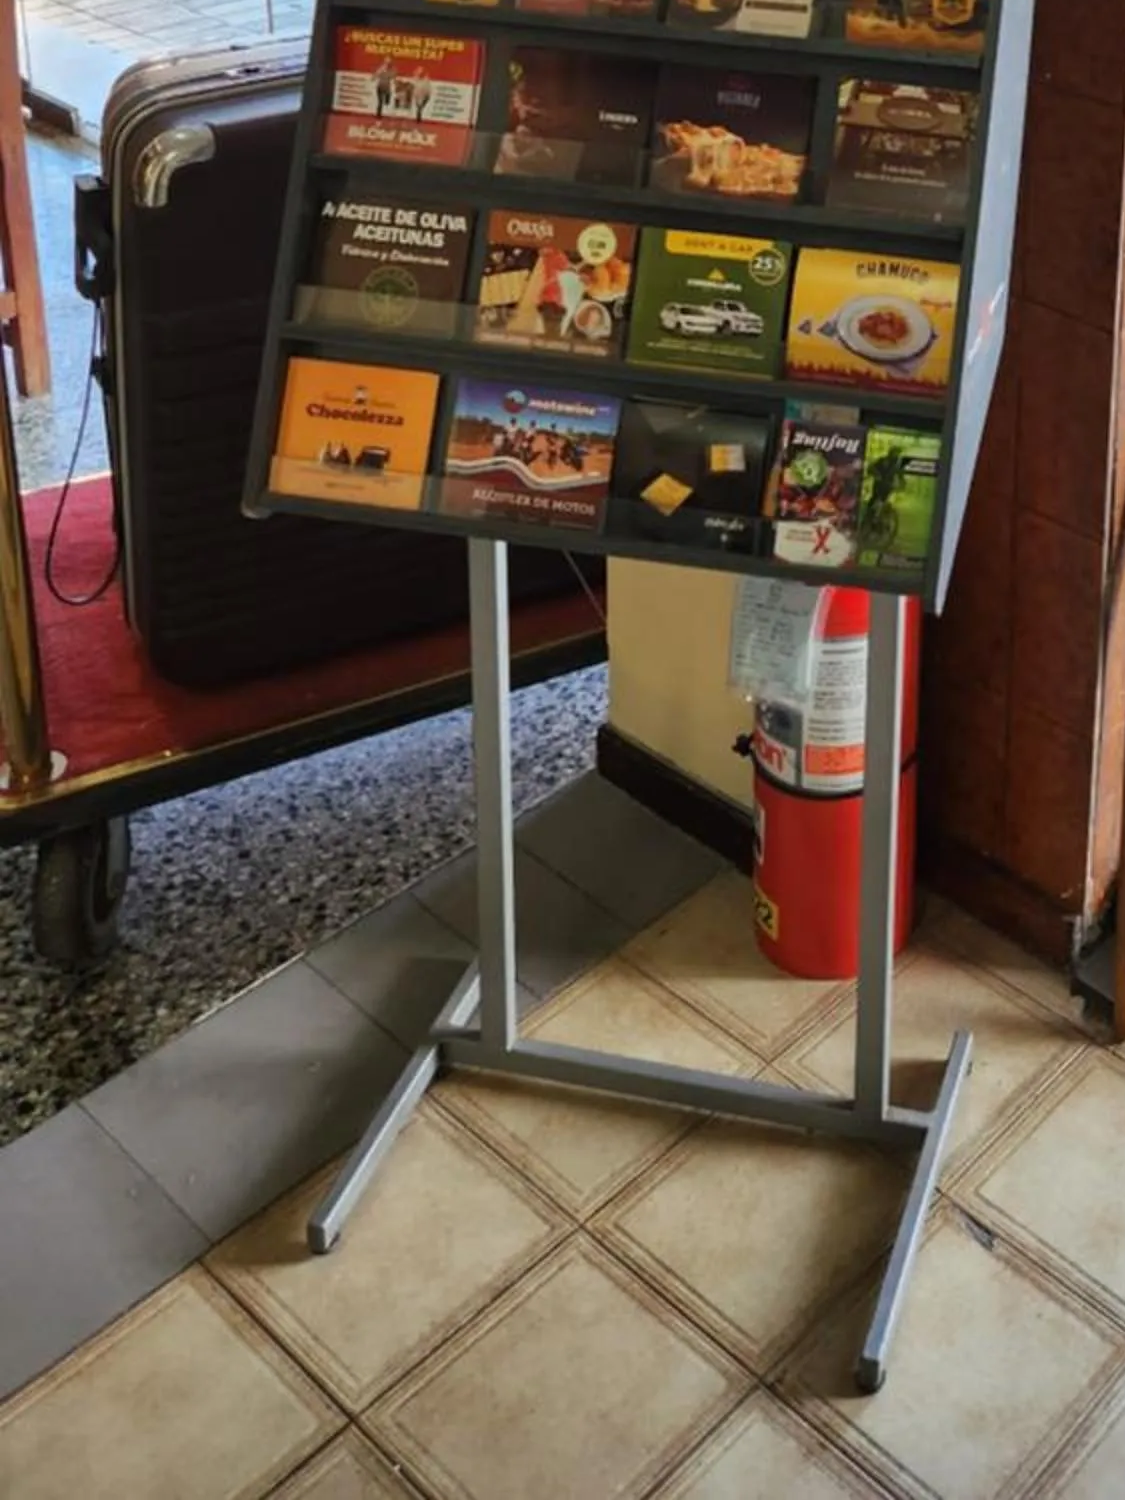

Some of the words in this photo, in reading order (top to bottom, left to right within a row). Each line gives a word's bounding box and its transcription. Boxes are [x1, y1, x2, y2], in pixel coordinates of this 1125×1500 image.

[336, 202, 393, 224] ACEITE
[394, 208, 418, 227] DE
[420, 211, 468, 233] OLIVA
[353, 223, 446, 248] ACEITUNAS
[306, 402, 405, 427] Chocolezza
[533, 497, 551, 510] DE
[552, 500, 597, 517] MOTOS
